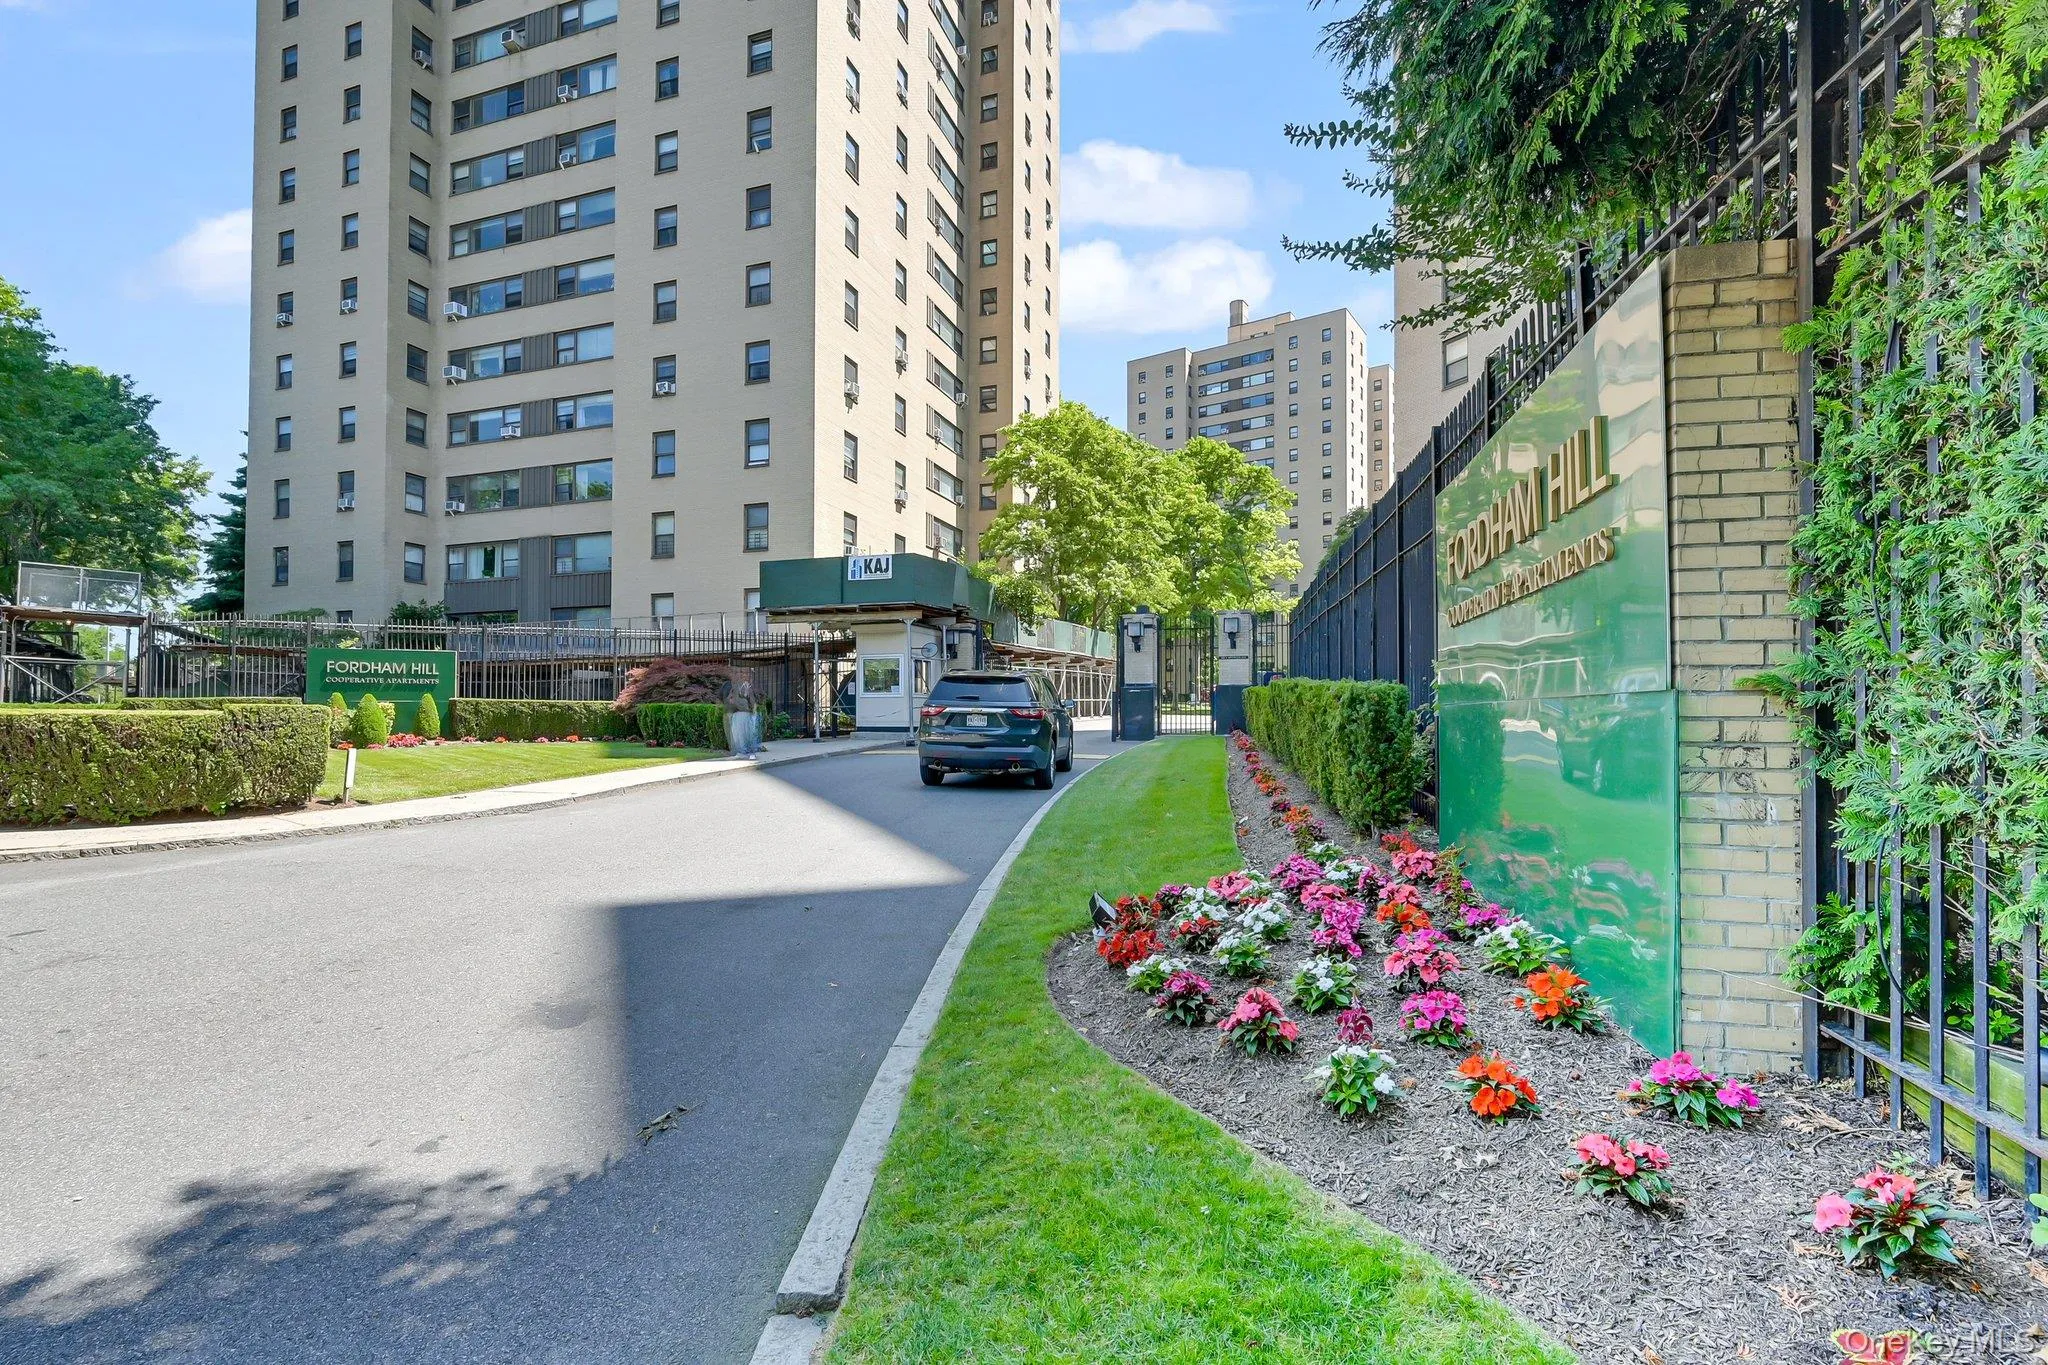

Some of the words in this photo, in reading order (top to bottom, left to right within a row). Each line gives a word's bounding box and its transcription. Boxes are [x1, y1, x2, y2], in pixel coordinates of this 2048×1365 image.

[1446, 466, 1543, 585] FORDHAM
[1548, 415, 1613, 522] HILL
[864, 557, 890, 574] KAJ
[1447, 579, 1512, 628] COOPERATIVE
[1510, 527, 1615, 600] APARTMENTS
[326, 660, 406, 675] FORDHAM
[411, 662, 439, 675] HILL
[325, 676, 385, 684] COOPERATIVE
[386, 677, 440, 685] APARTMENTS
